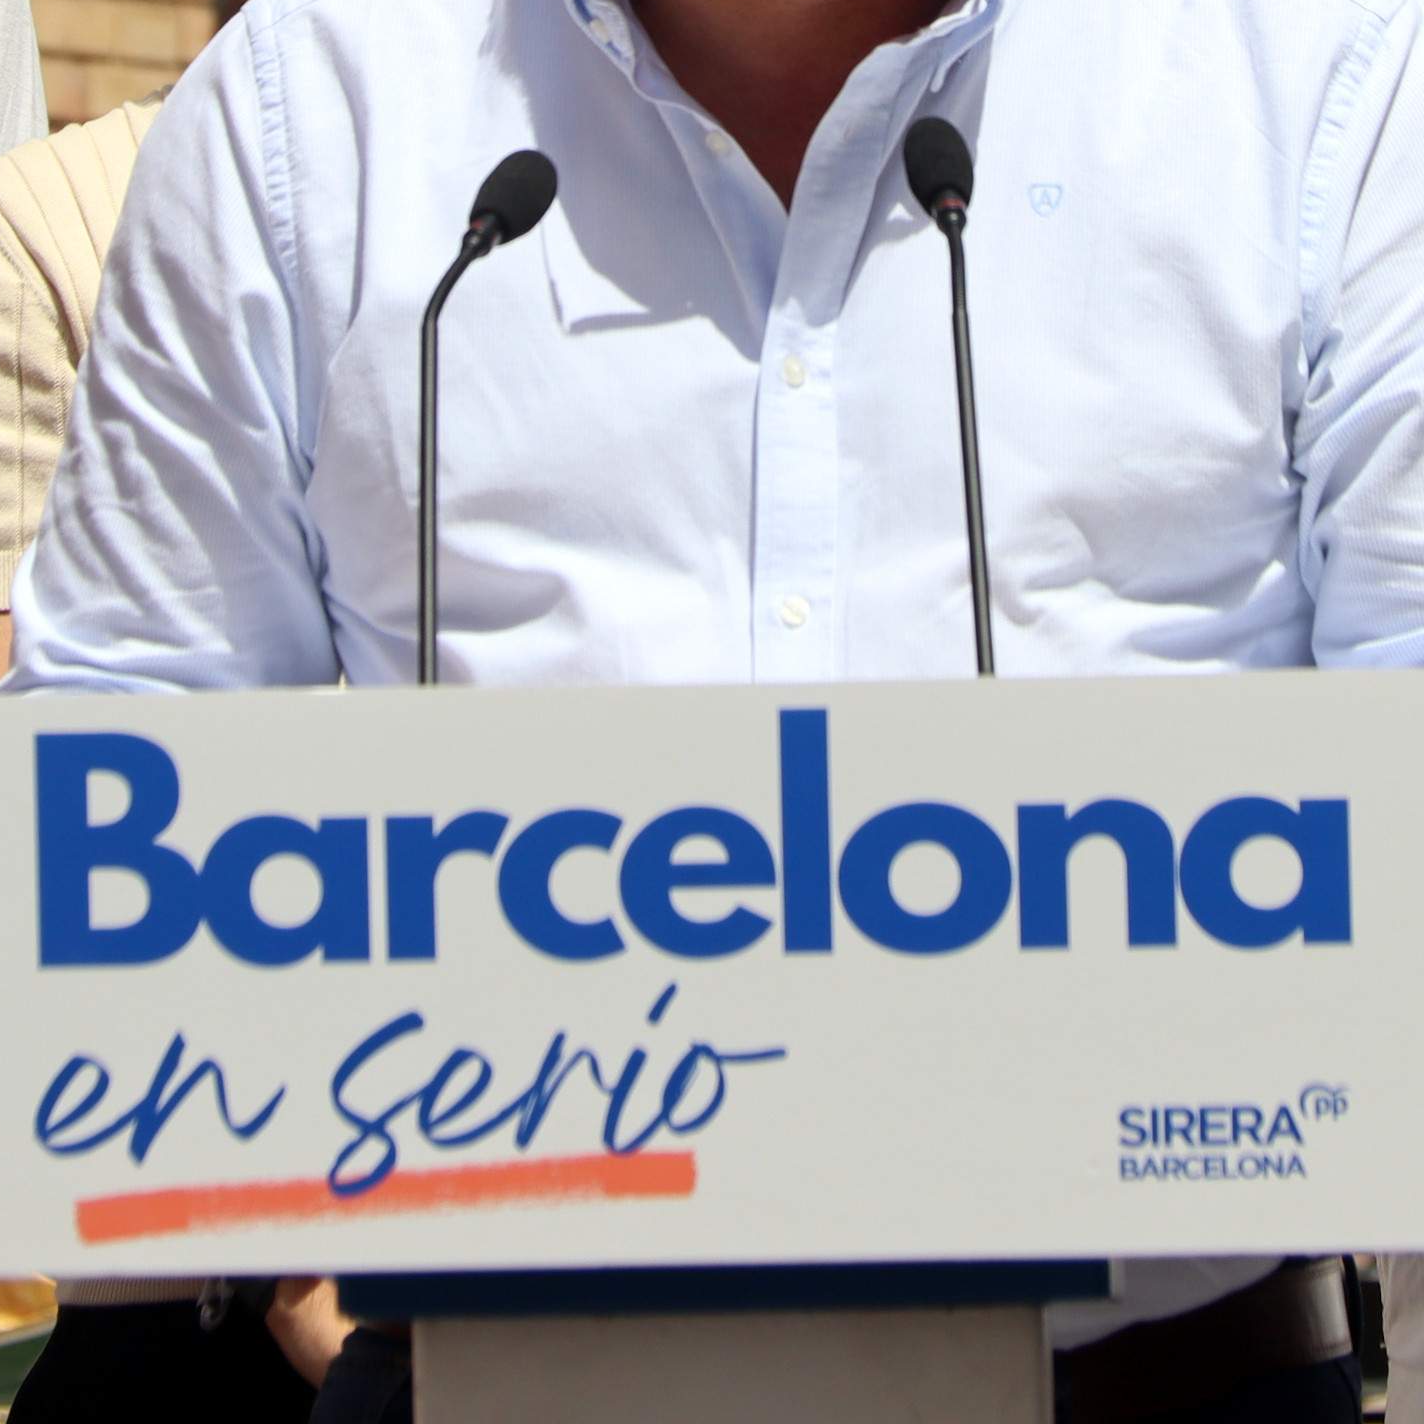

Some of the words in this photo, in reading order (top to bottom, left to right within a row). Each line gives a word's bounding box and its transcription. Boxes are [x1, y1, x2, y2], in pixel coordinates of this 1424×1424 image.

[33, 706, 1354, 969] Barcelona
[34, 1032, 287, 1164] en
[328, 980, 787, 1197] serio
[1118, 1102, 1305, 1148] SIRERA
[1118, 1154, 1307, 1180] BARCELONA
